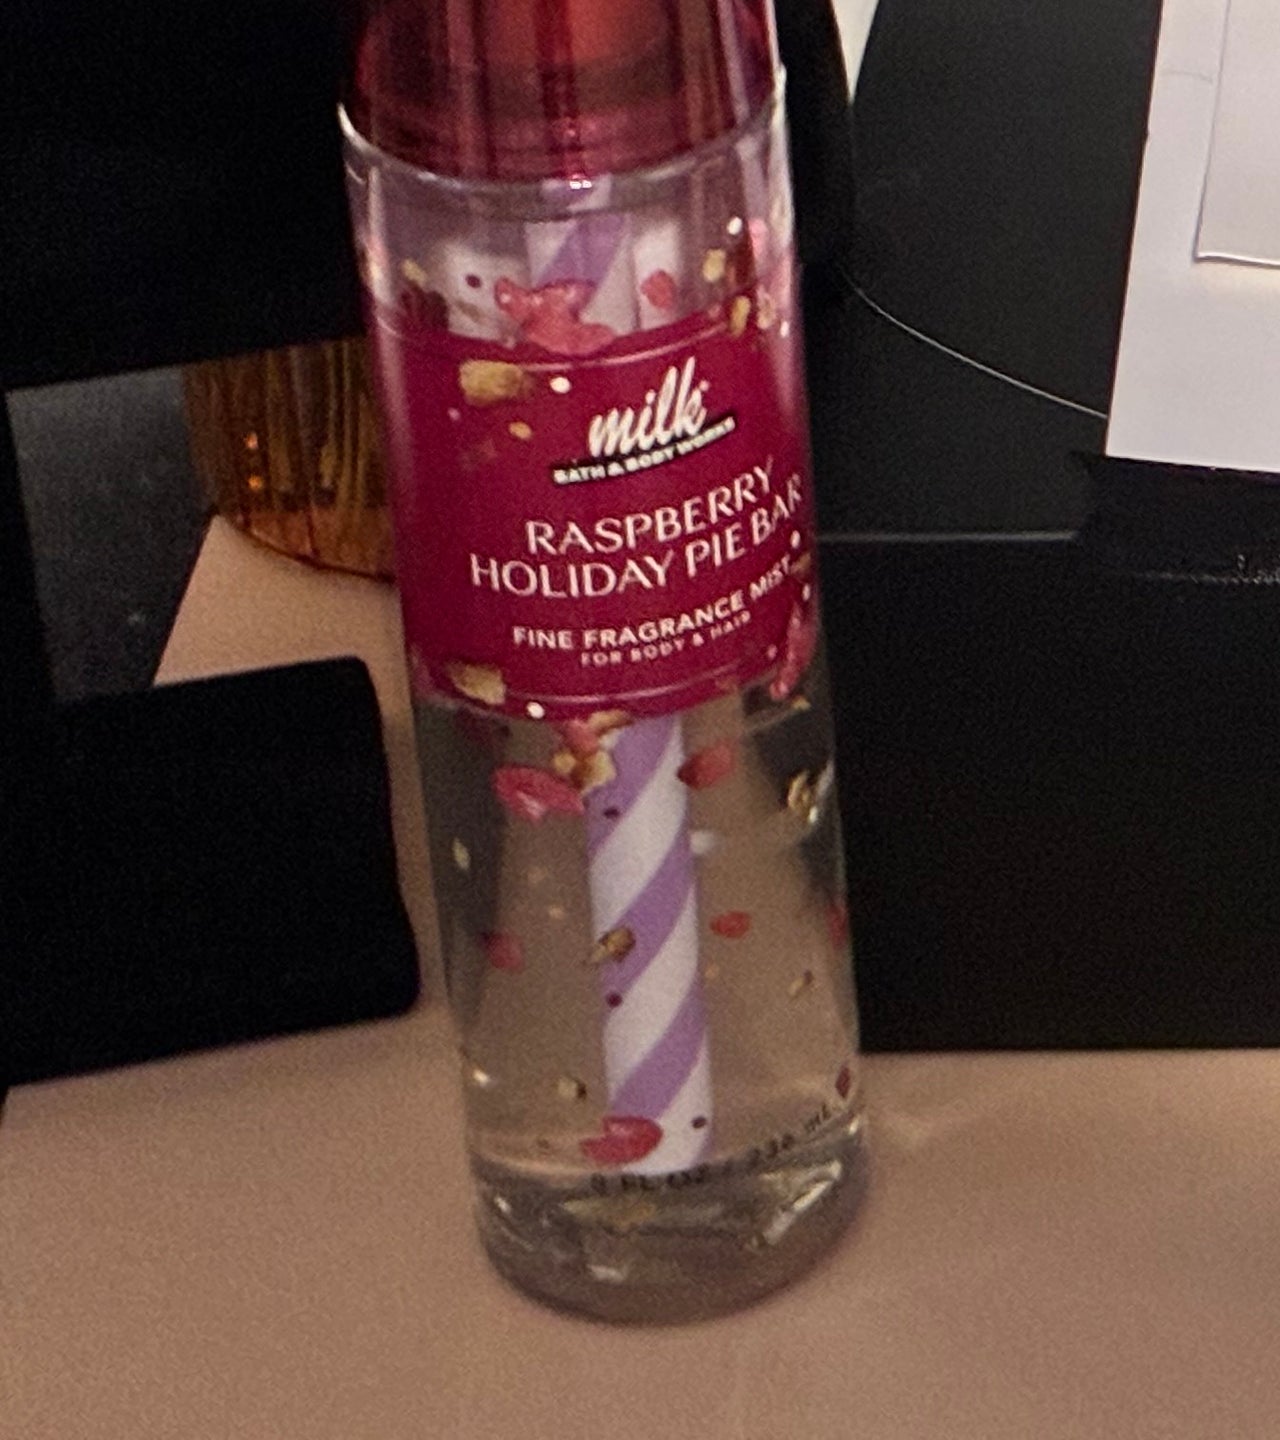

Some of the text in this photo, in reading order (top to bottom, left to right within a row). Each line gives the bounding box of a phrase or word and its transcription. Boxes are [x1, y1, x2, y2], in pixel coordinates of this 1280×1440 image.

[588, 356, 709, 458] milk
[470, 472, 801, 599] HOLIDAY PIE BAR
[525, 454, 773, 555] RASPBERRY
[513, 553, 791, 650] FINE FRAGRANCE MIST
[581, 651, 620, 667] FOR
[630, 642, 685, 663] BODY
